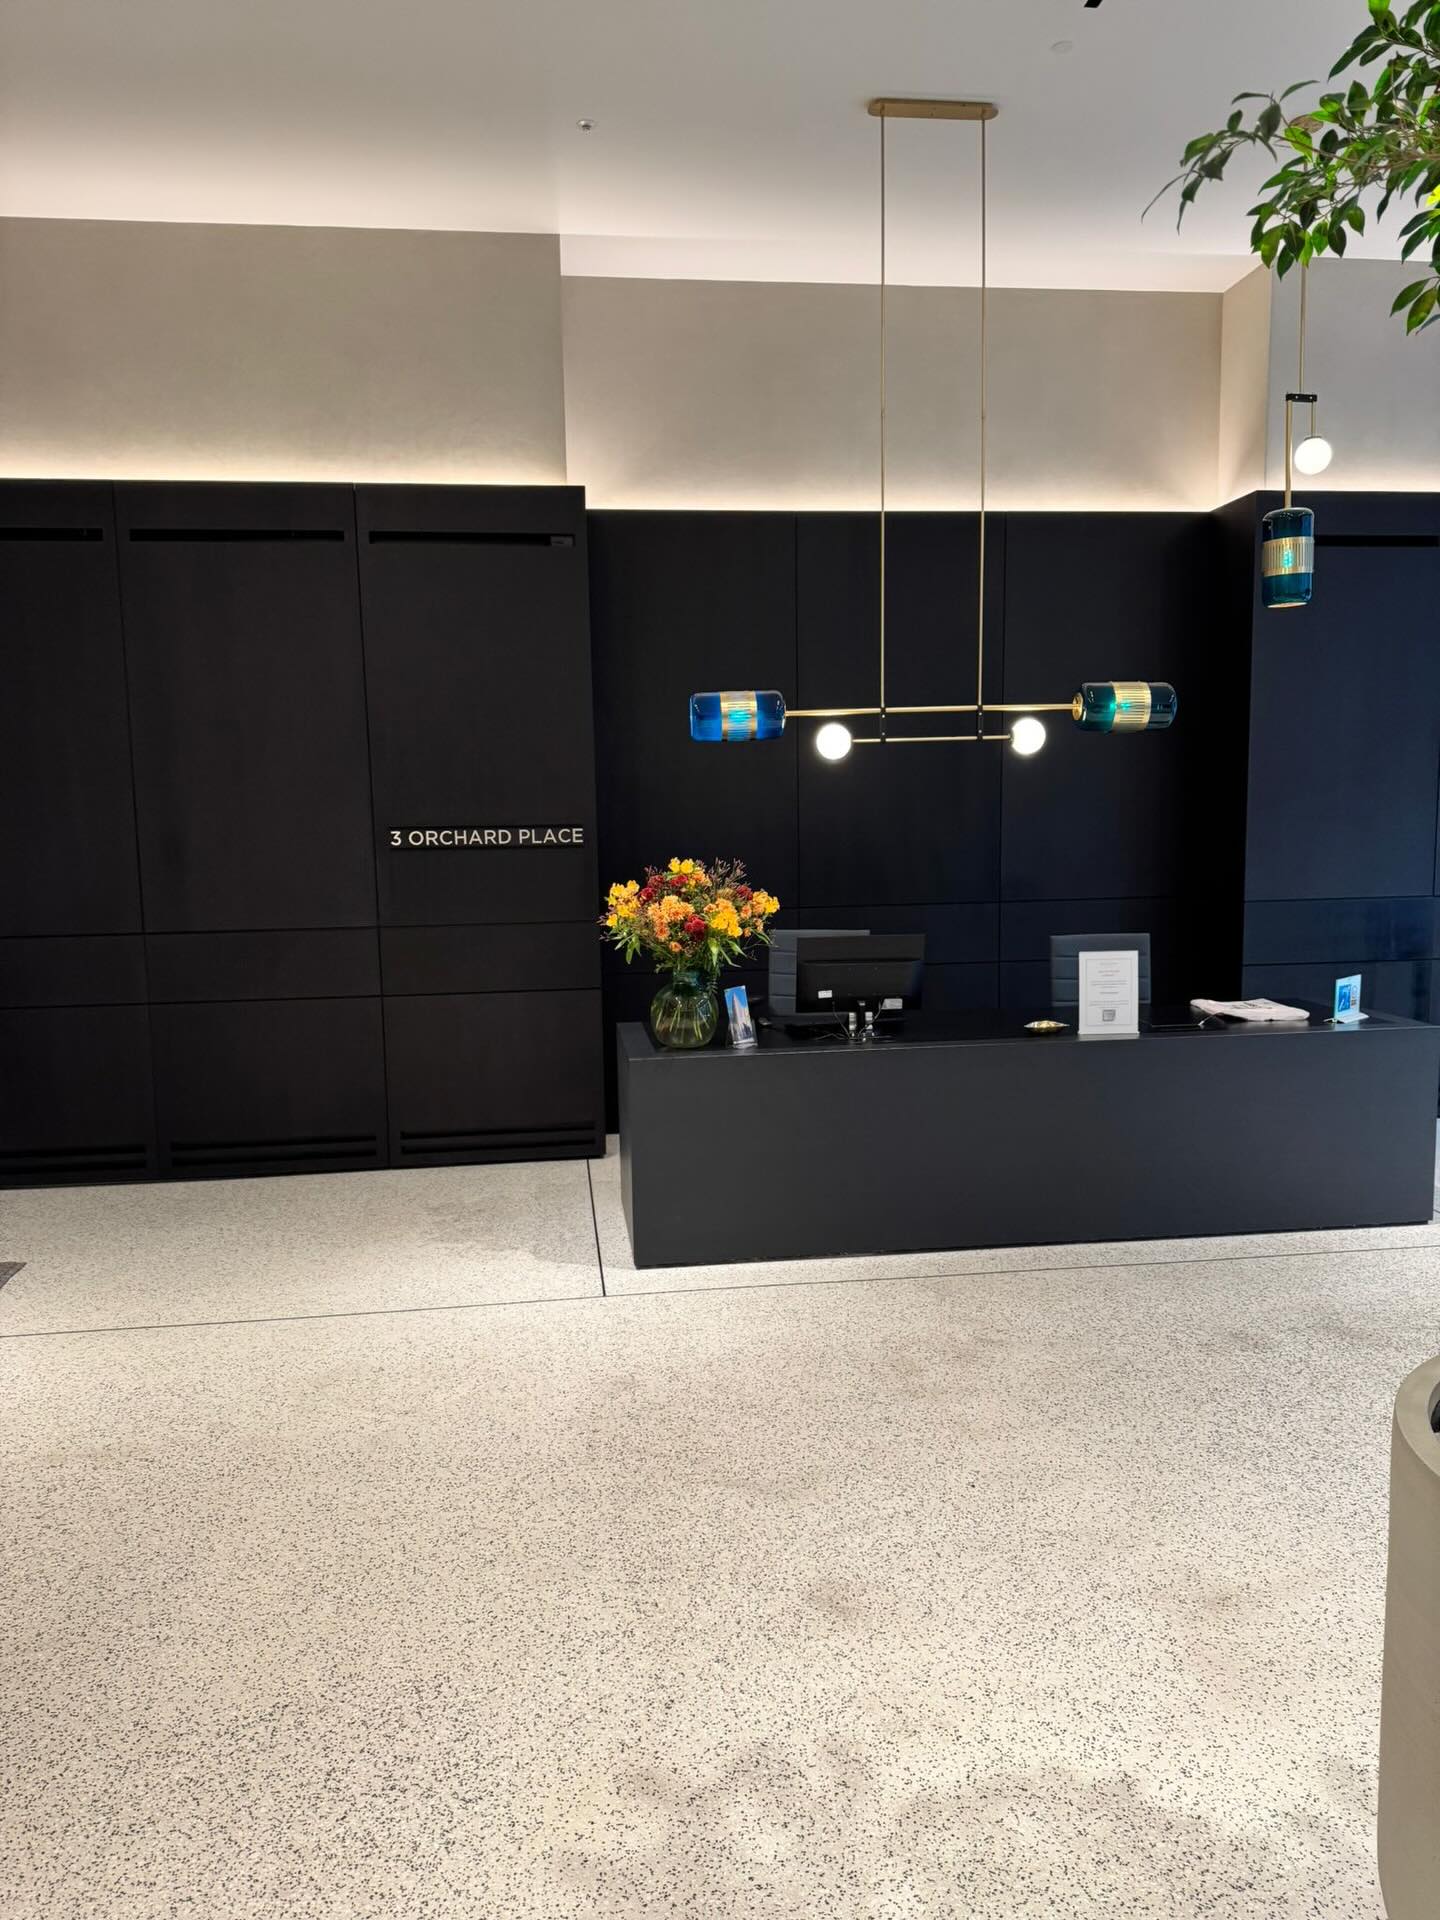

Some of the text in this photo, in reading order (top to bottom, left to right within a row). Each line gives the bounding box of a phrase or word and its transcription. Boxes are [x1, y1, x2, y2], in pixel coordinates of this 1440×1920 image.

[390, 828, 584, 846] 3 ORCHARD PLACE
